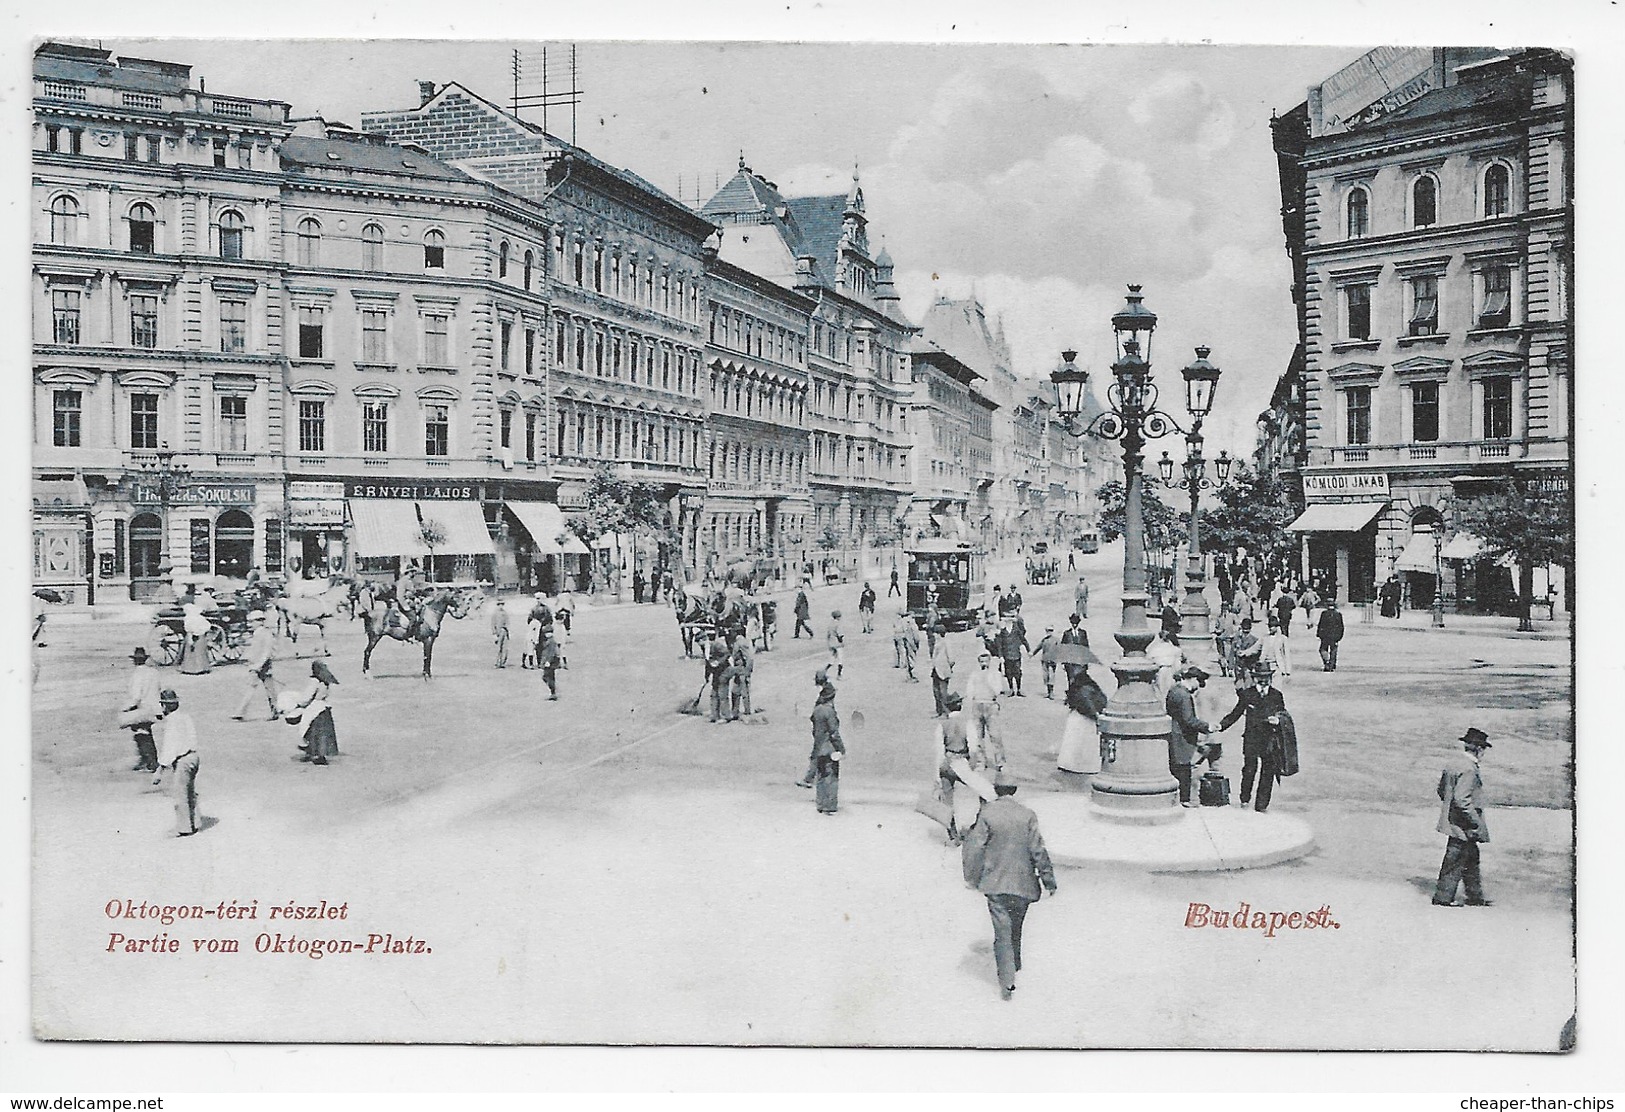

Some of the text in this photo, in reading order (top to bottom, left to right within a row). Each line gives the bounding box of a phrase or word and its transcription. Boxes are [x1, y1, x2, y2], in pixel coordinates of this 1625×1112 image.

[1384, 77, 1431, 110] STYRIA
[1351, 476, 1384, 487] JAKAB
[197, 485, 251, 503] SOKULSKI
[353, 485, 418, 498] ERNYEI
[424, 486, 472, 498] LAJOS
[926, 590, 940, 603] 57
[105, 899, 348, 924] Oktogon-téri részlet
[106, 932, 432, 958] Partie vom Oktogon-Platz.
